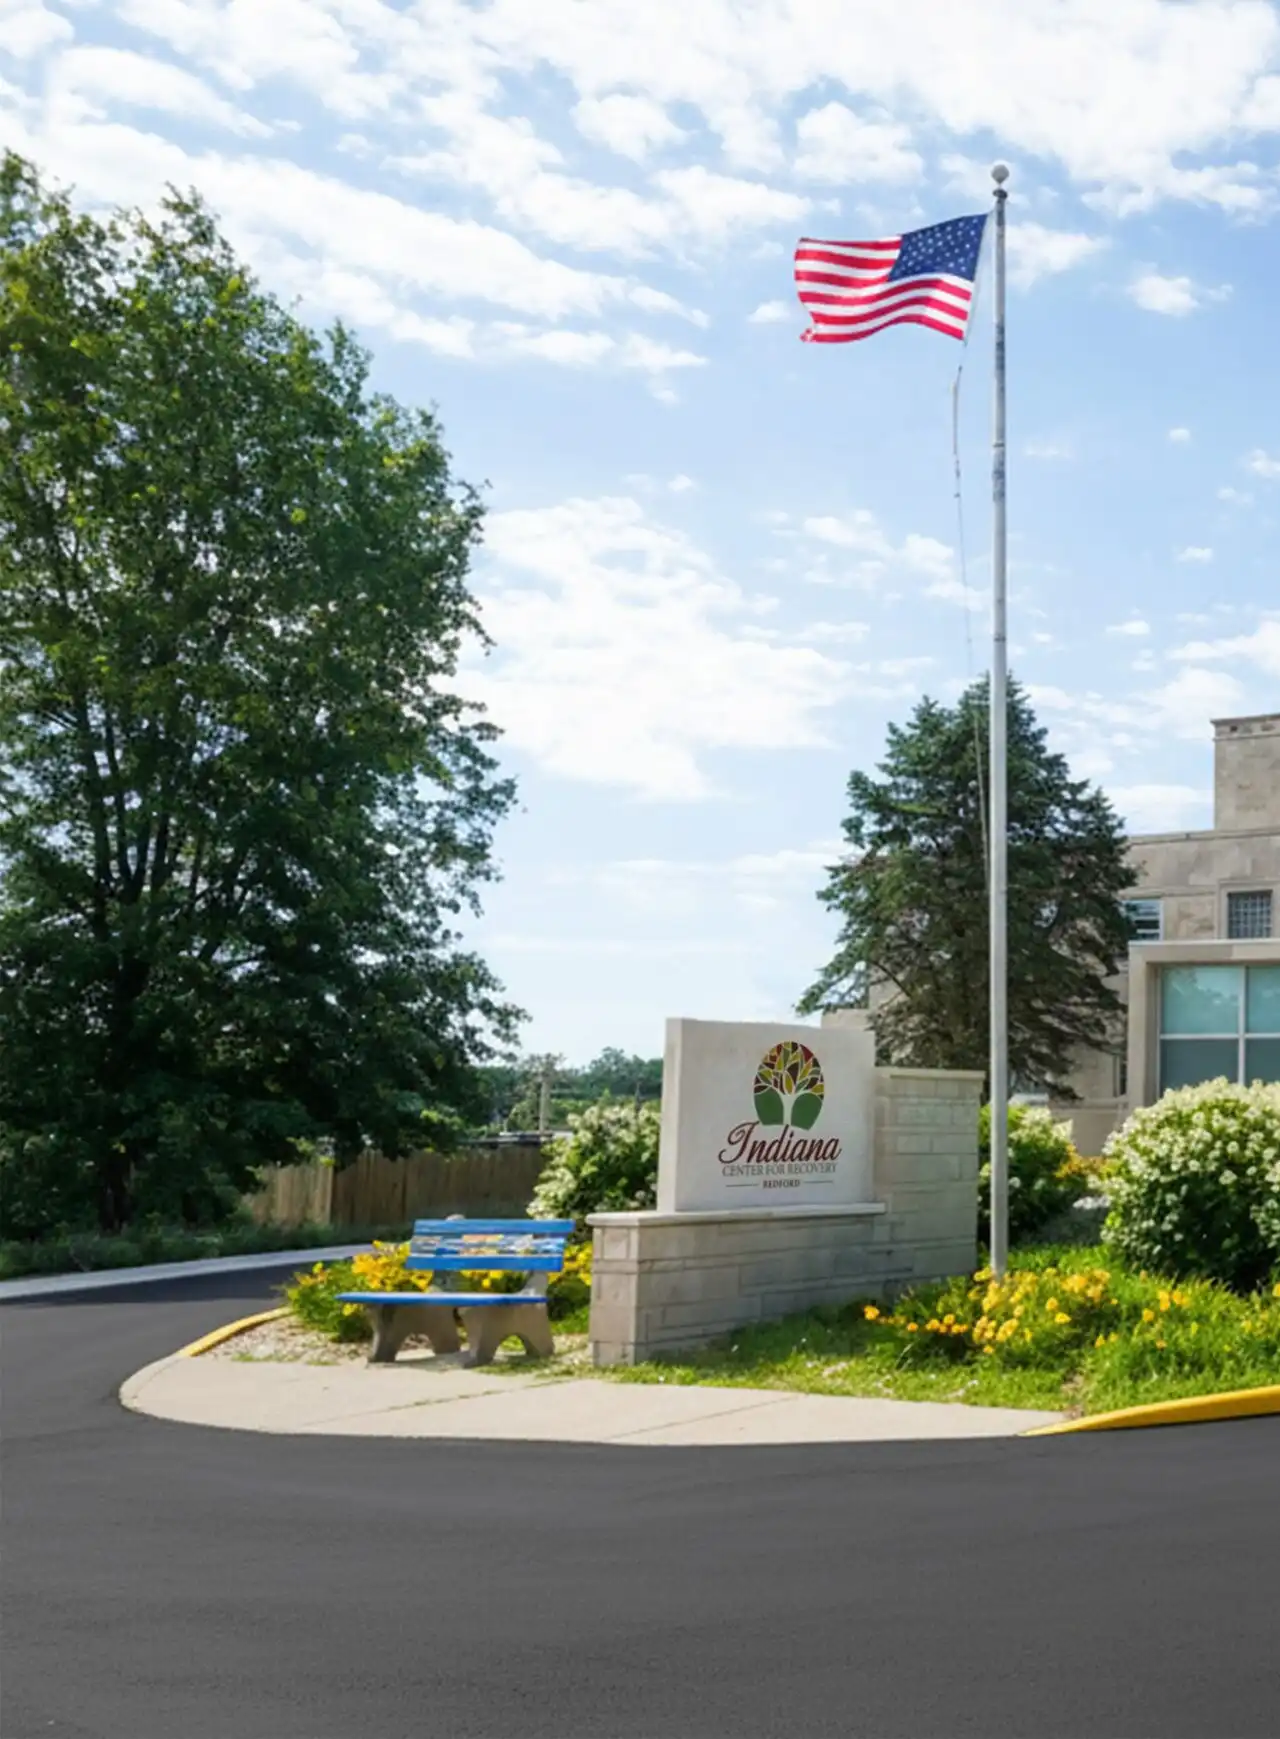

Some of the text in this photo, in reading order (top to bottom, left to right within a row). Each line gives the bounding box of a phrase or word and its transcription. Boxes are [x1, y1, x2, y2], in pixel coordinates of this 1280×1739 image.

[718, 1121, 842, 1164] Indiana
[722, 1162, 837, 1177] CENTER FOR RECOVERY
